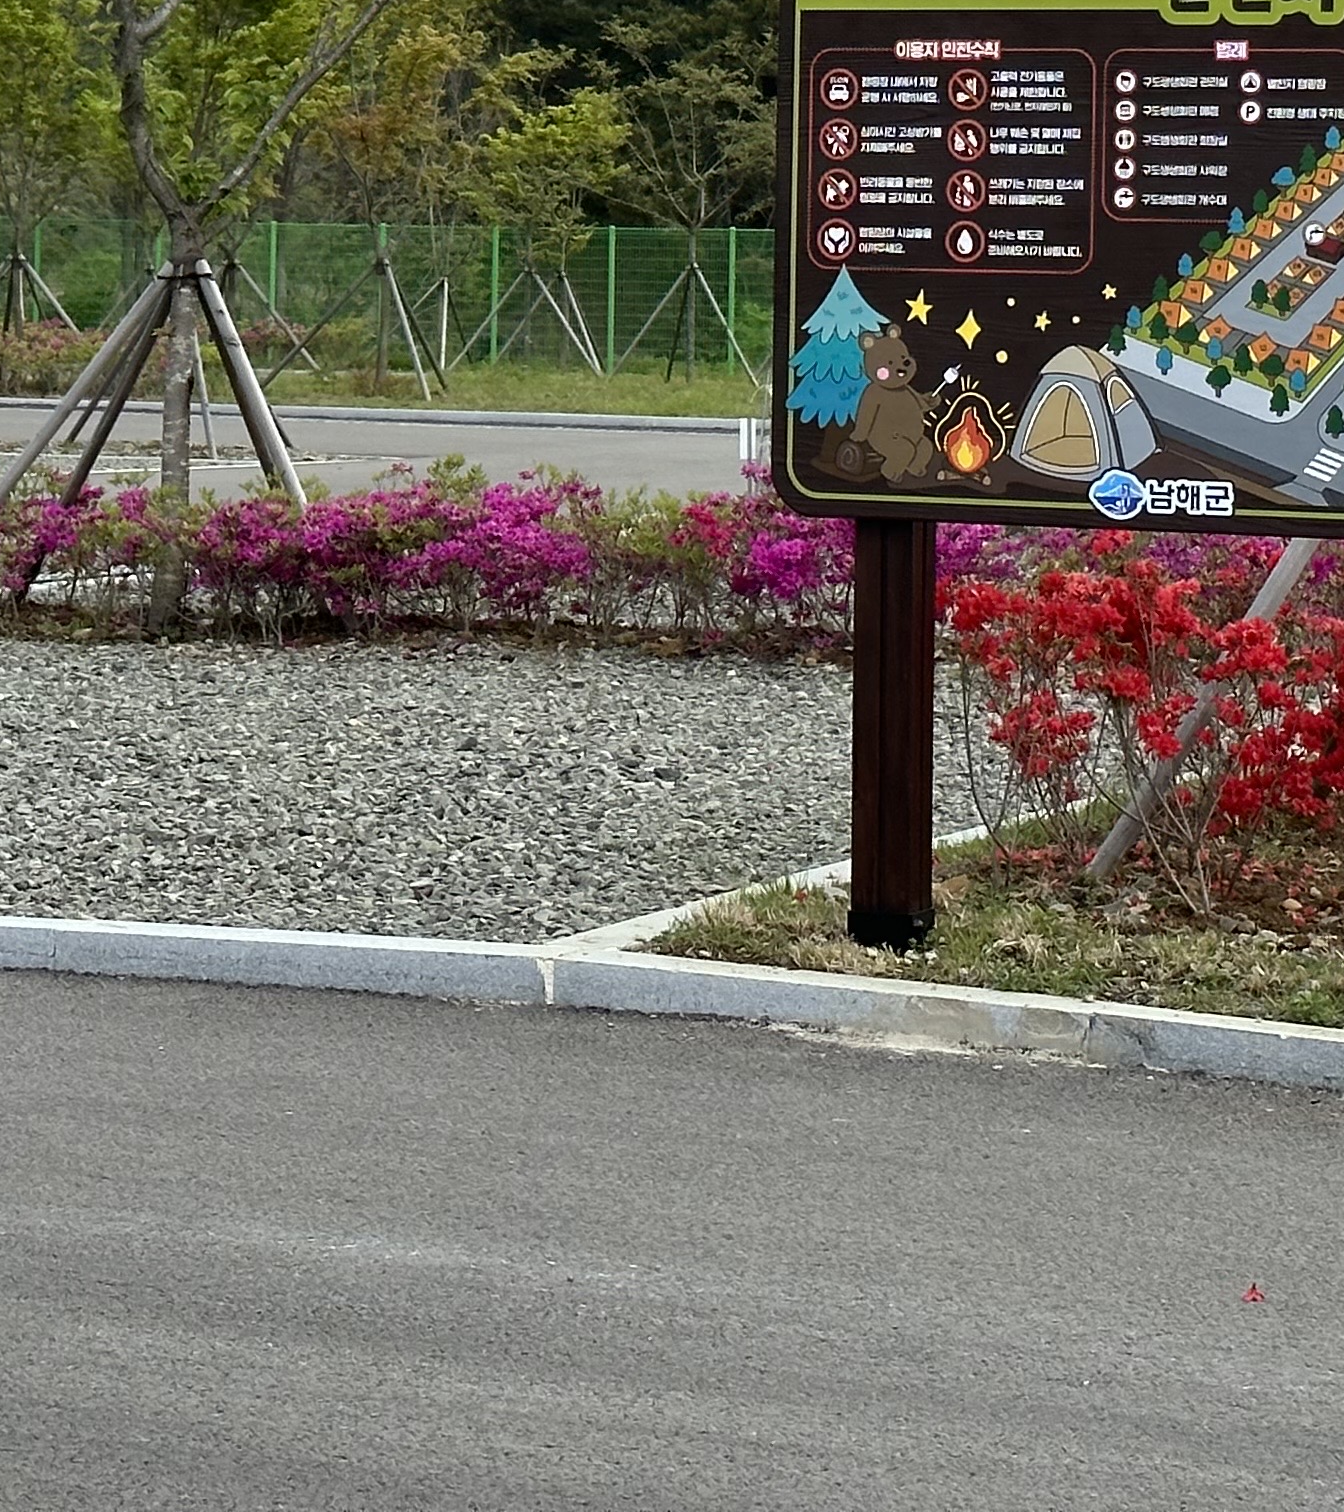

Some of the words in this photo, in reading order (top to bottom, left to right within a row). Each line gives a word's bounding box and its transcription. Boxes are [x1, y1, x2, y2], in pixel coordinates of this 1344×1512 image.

[896, 41, 938, 58] 이용자
[942, 41, 999, 59] 안전수칙
[1246, 106, 1256, 118] P
[990, 127, 1008, 139] 나무
[988, 229, 1015, 241] 식수는
[1149, 484, 1229, 511] 남해군
